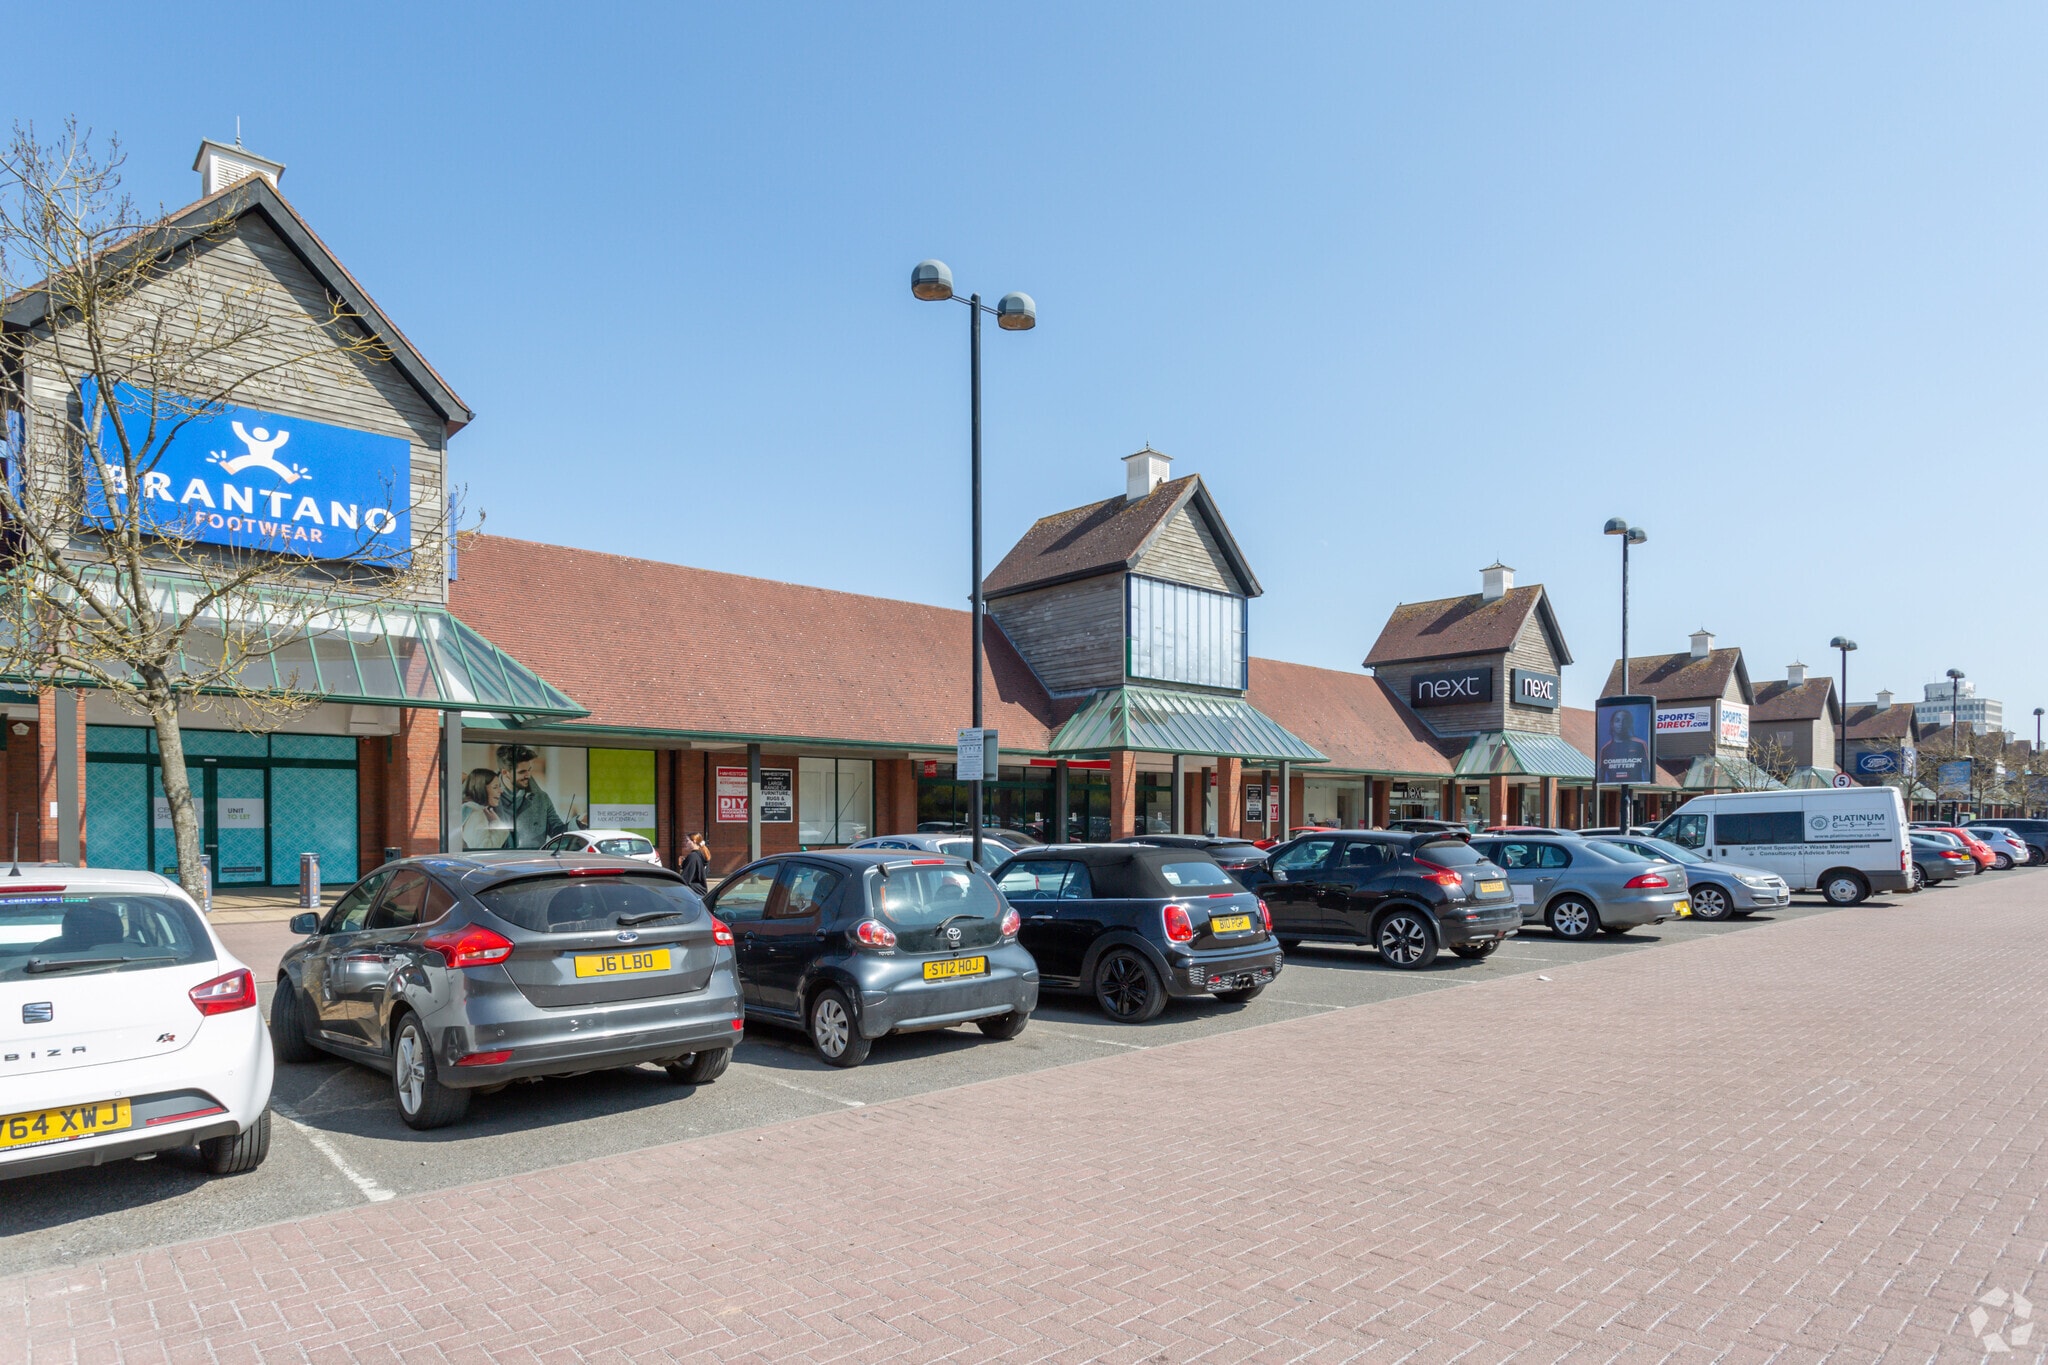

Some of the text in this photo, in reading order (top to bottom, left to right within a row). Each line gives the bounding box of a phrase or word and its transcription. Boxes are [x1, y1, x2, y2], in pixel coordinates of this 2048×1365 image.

[105, 463, 397, 534] BRANTANO
[195, 511, 323, 544] FOOTWEAR
[1418, 676, 1480, 699] next
[1524, 677, 1554, 700] next
[1657, 713, 1695, 722] SPORTS
[1722, 710, 1742, 725] SPORTS
[1838, 776, 1846, 786] 5
[720, 798, 748, 809] DIY
[1832, 813, 1885, 822] PLATINUM
[596, 953, 653, 972] J6 LBO
[931, 959, 979, 975] ST12 HOJ
[60, 1103, 119, 1133] XWJ
